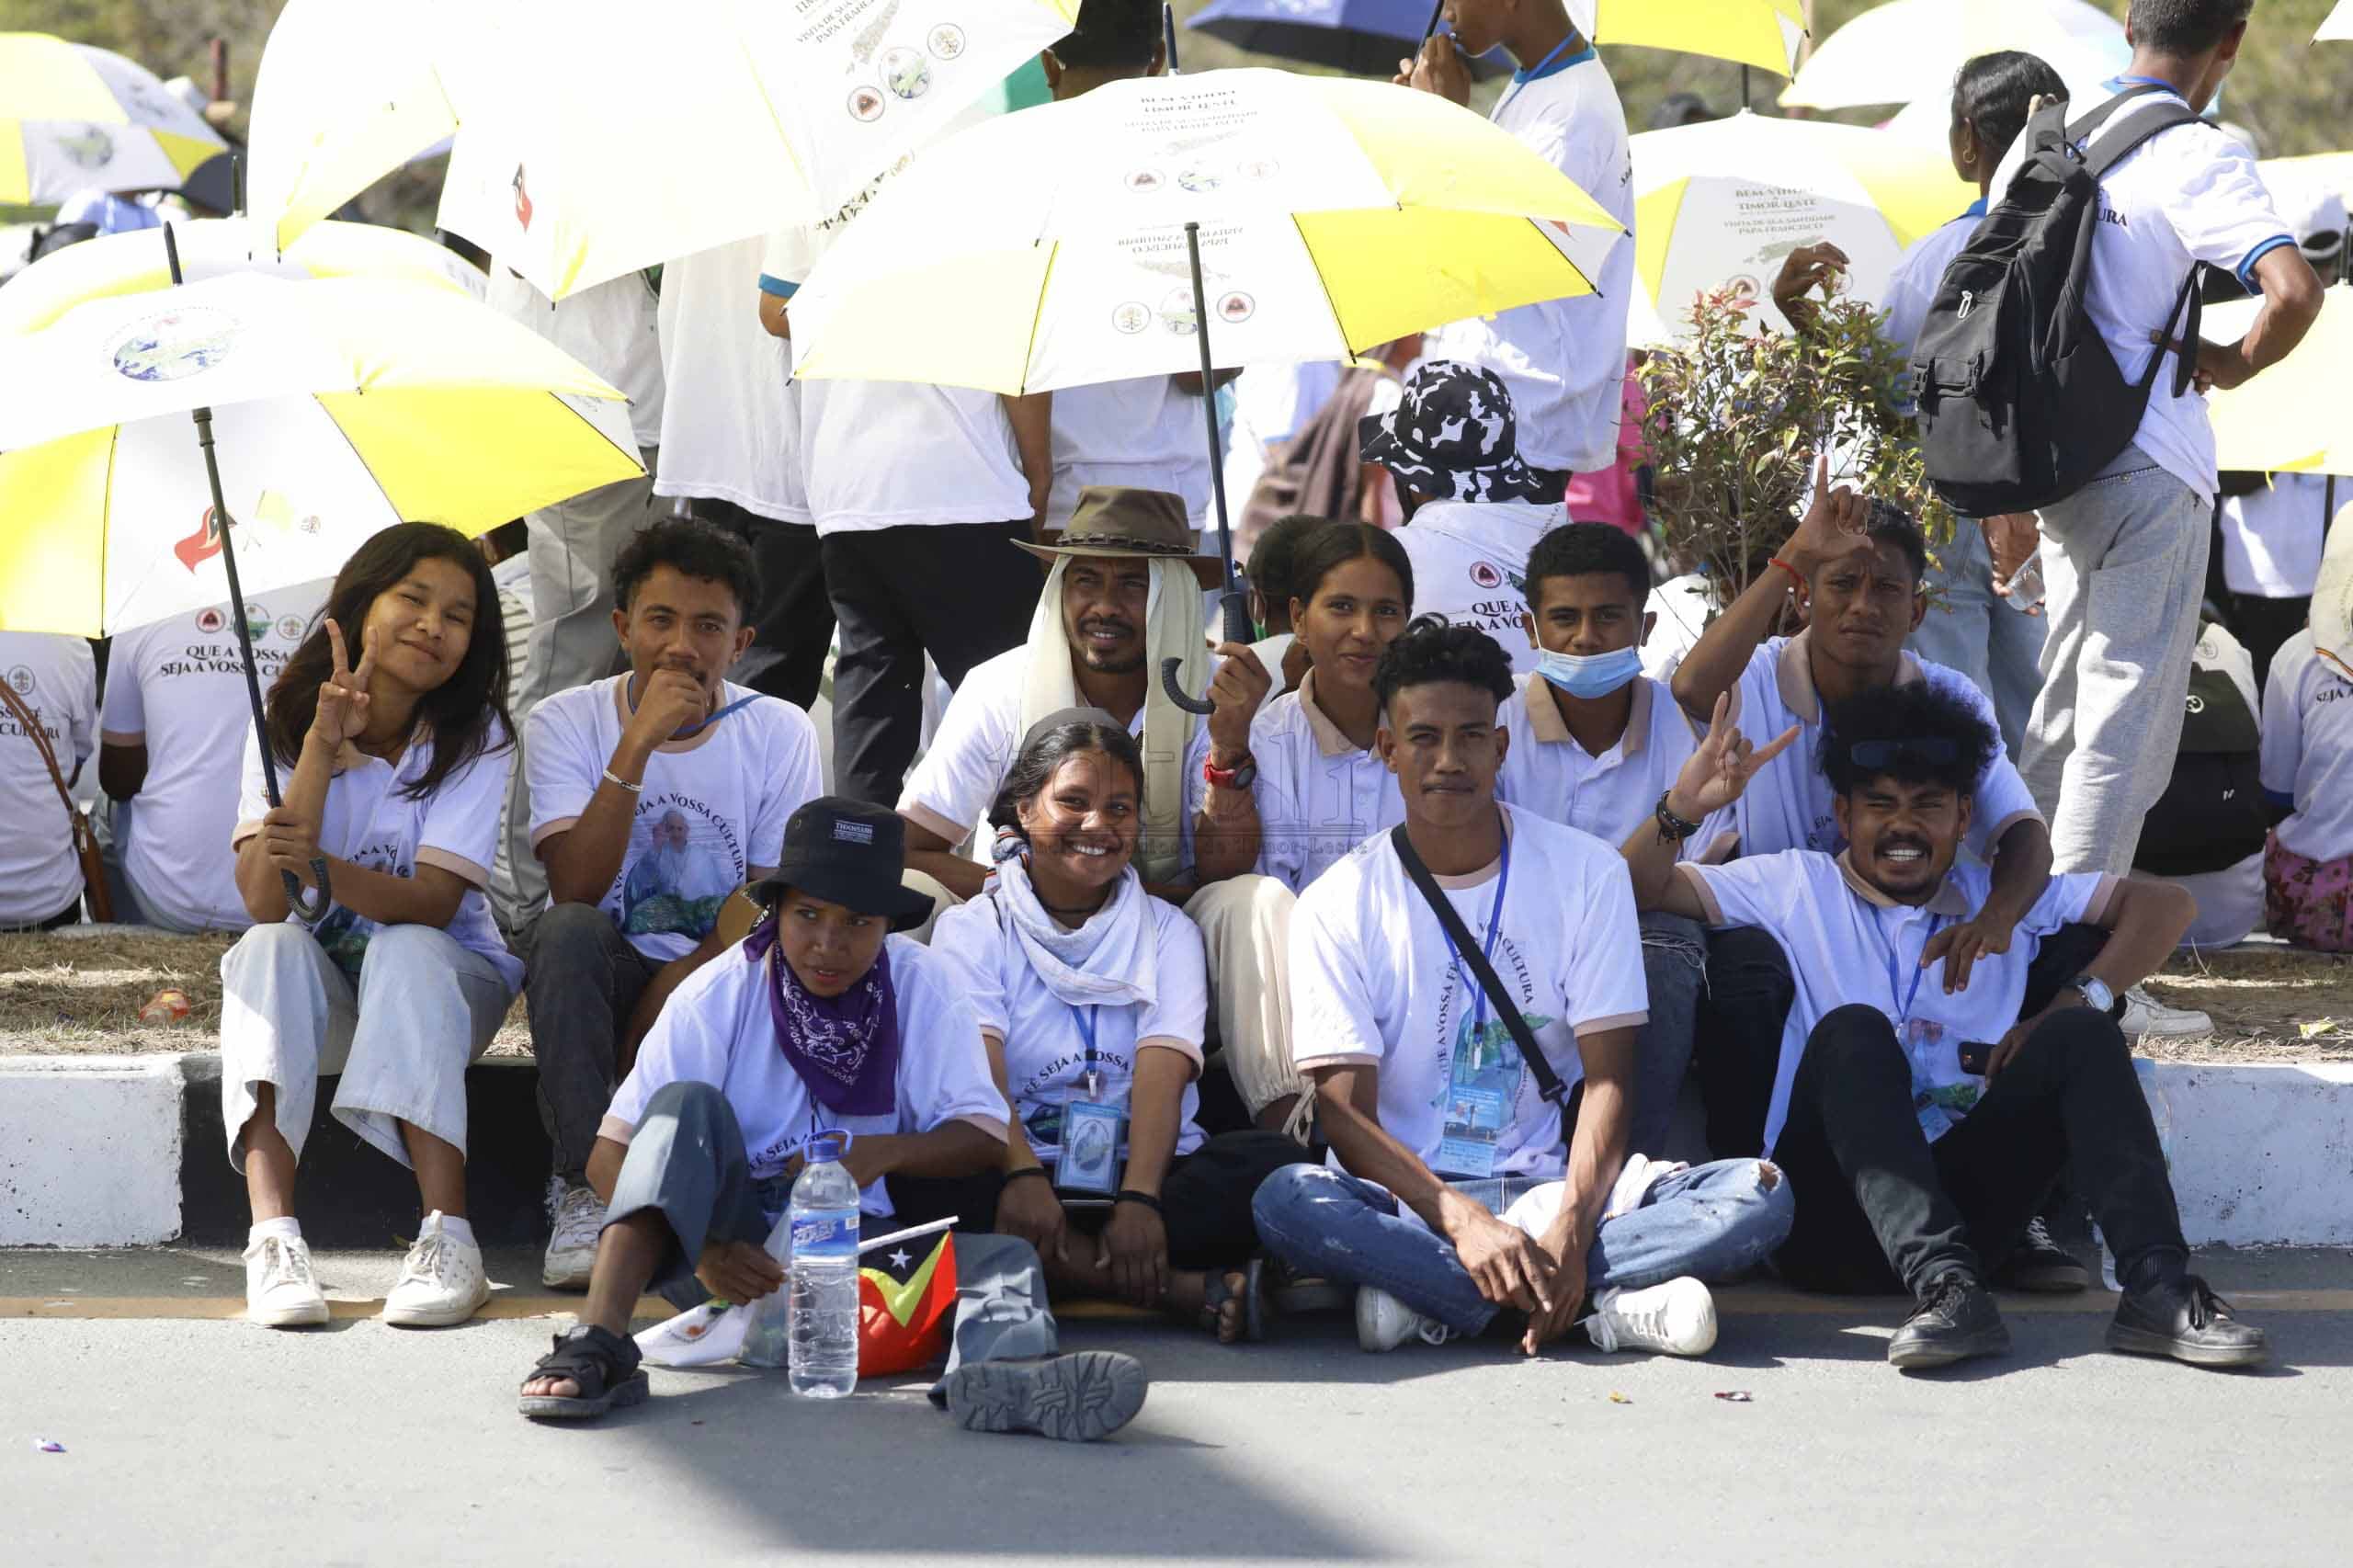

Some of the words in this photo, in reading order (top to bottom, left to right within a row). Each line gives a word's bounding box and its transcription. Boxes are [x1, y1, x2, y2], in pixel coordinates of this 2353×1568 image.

[1472, 600, 1508, 617] QUE
[187, 645, 221, 660] QUE
[223, 646, 233, 657] A
[161, 661, 191, 676] SEJA
[670, 793, 710, 819] VOSSA
[711, 814, 745, 881] CULTURA
[1502, 937, 1535, 1005] CULTURA
[1436, 984, 1454, 1034] VOSSA
[1040, 1056, 1070, 1081] SEJA
[1073, 1052, 1082, 1062] A
[766, 1136, 798, 1157] SEJA
